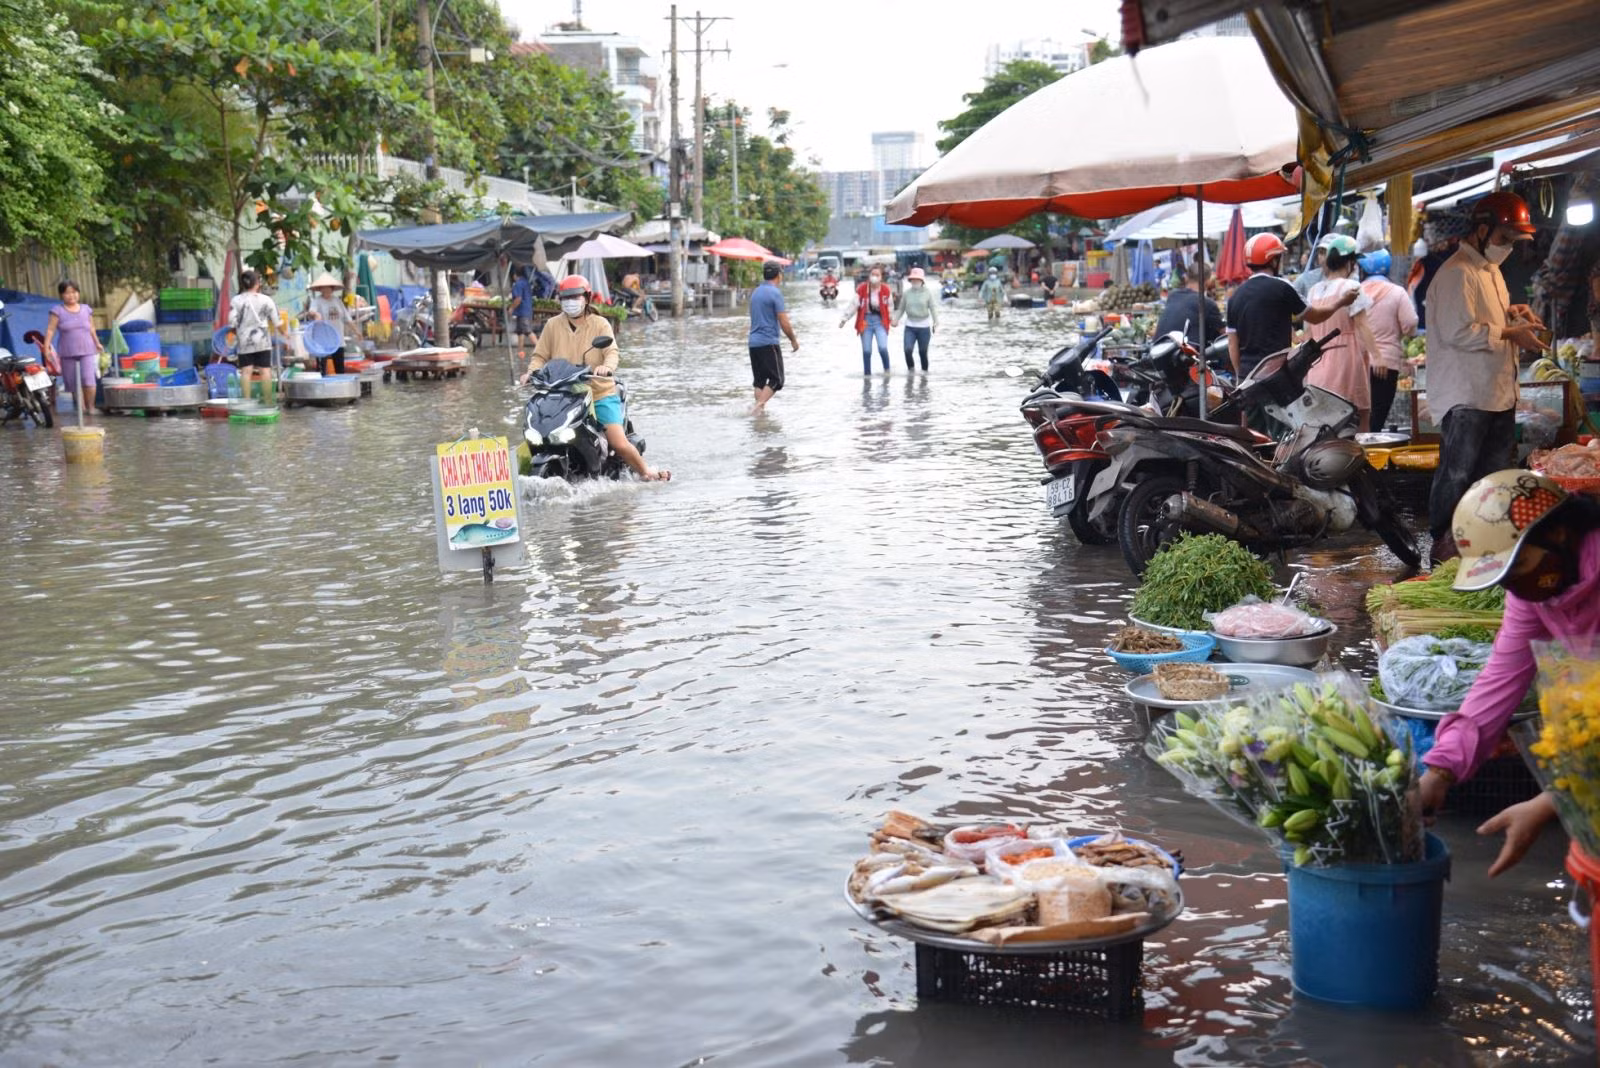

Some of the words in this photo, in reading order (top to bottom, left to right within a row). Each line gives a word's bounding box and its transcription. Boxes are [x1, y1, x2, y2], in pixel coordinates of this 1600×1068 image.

[446, 495, 455, 516] 3
[458, 494, 486, 519] lạng
[488, 488, 512, 511] 50k
